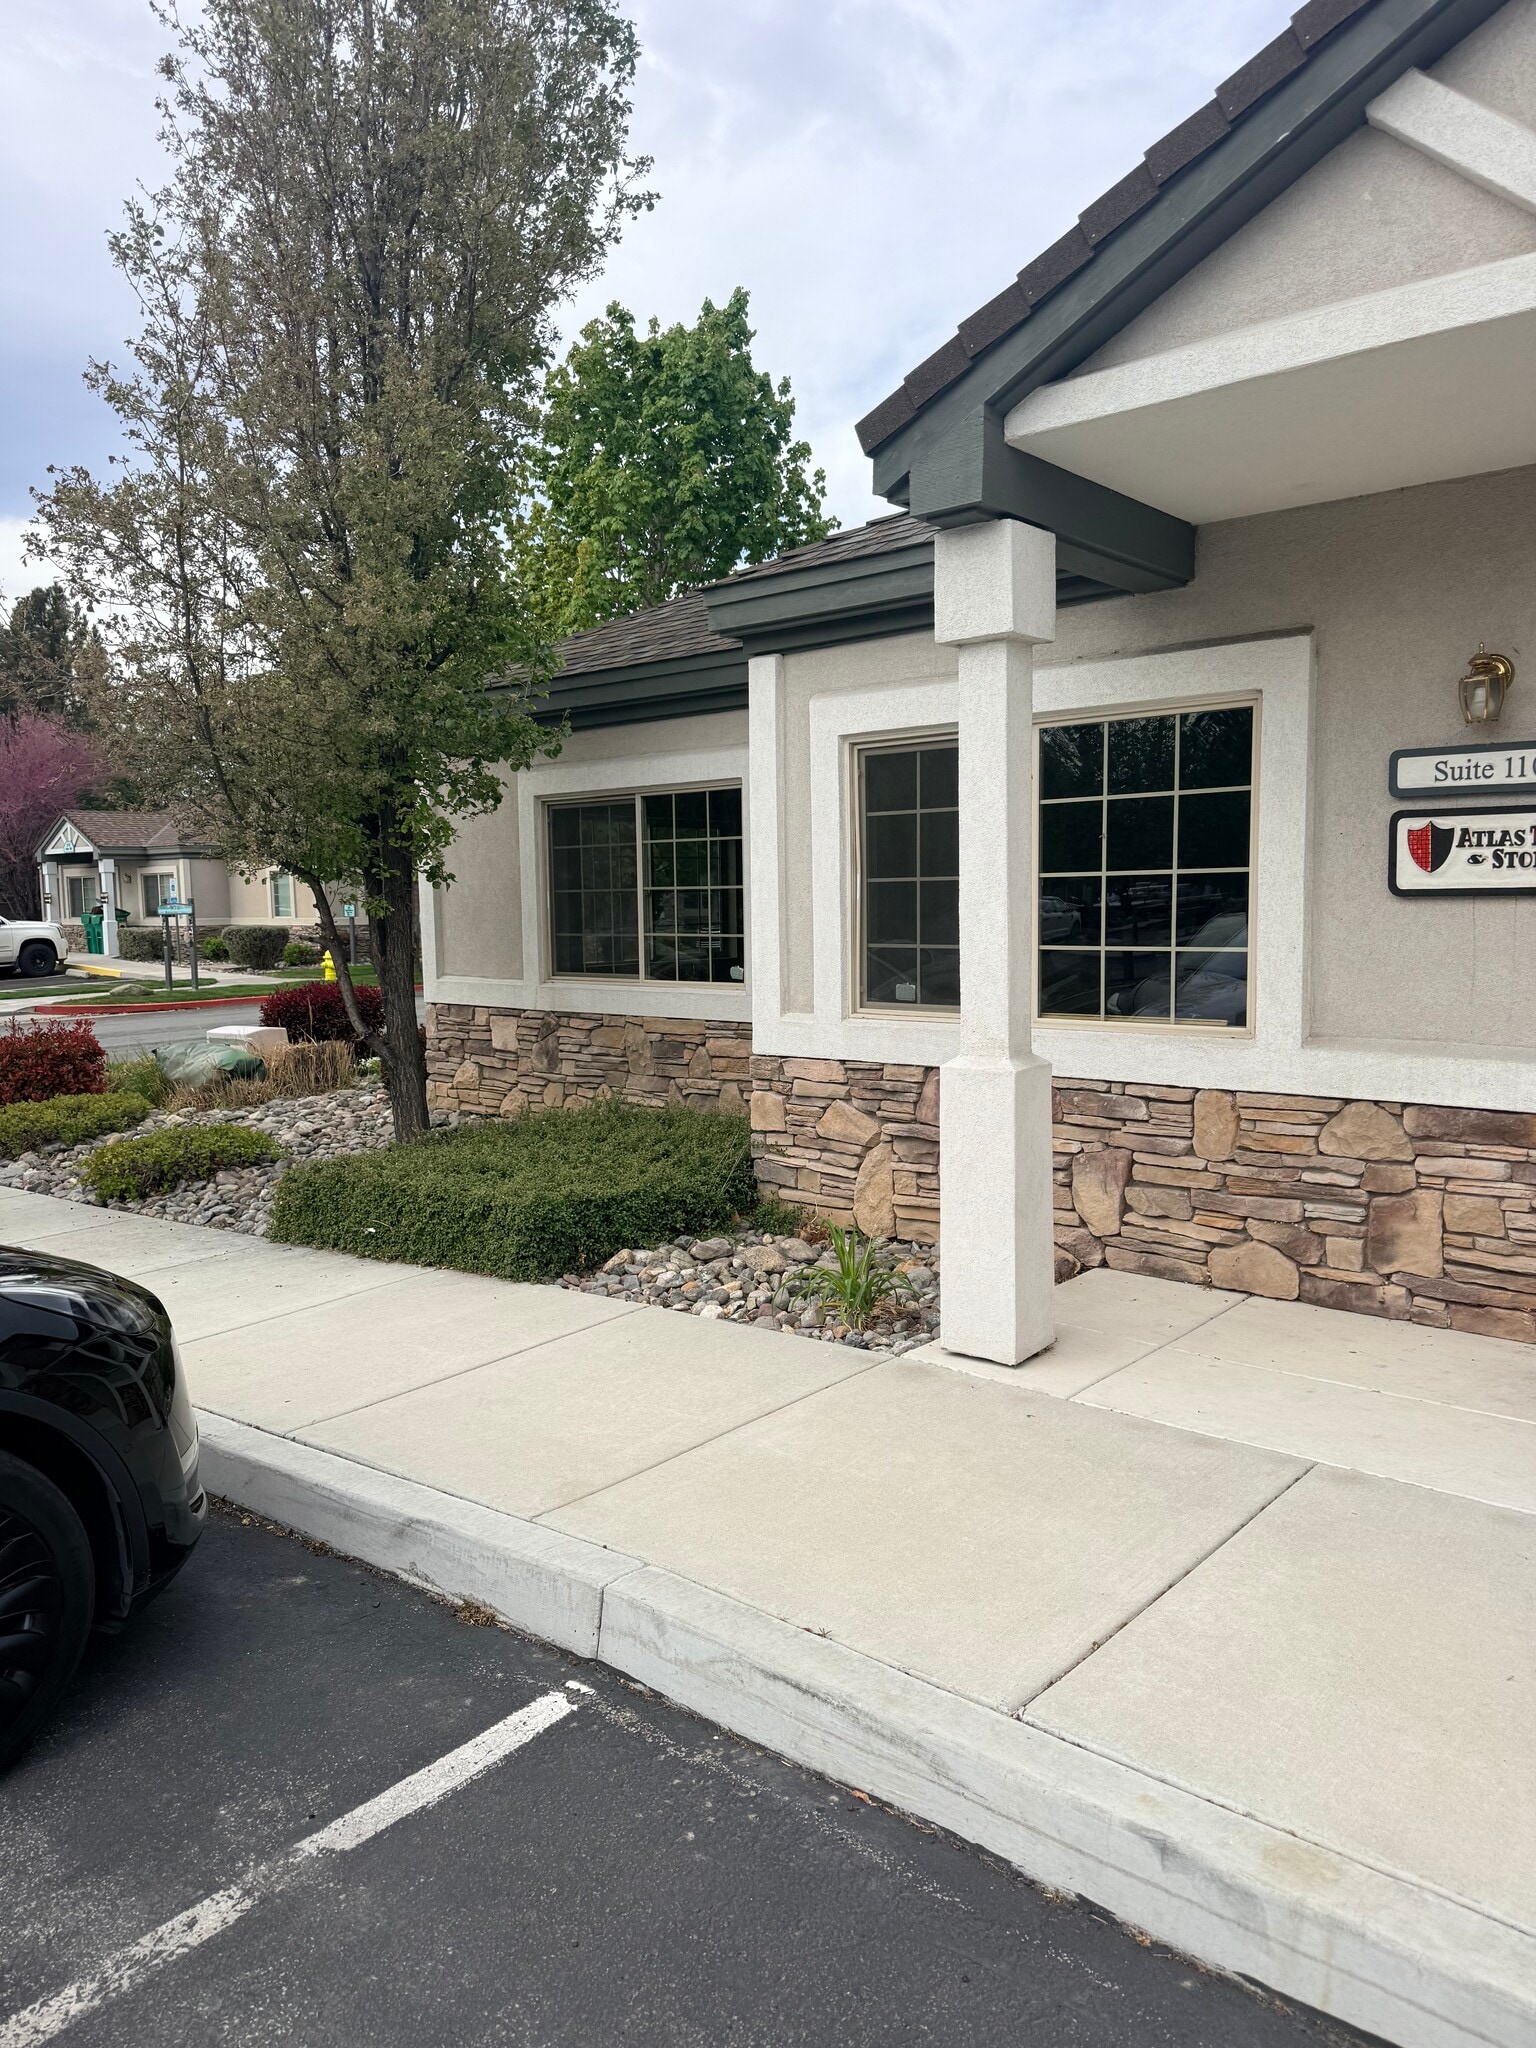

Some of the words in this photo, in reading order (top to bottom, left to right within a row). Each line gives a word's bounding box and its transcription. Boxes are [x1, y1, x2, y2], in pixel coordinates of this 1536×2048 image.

[1434, 758, 1494, 783] Suite
[1505, 755, 1536, 778] 11
[1455, 827, 1526, 848] ATLAS
[1492, 848, 1536, 869] STO
